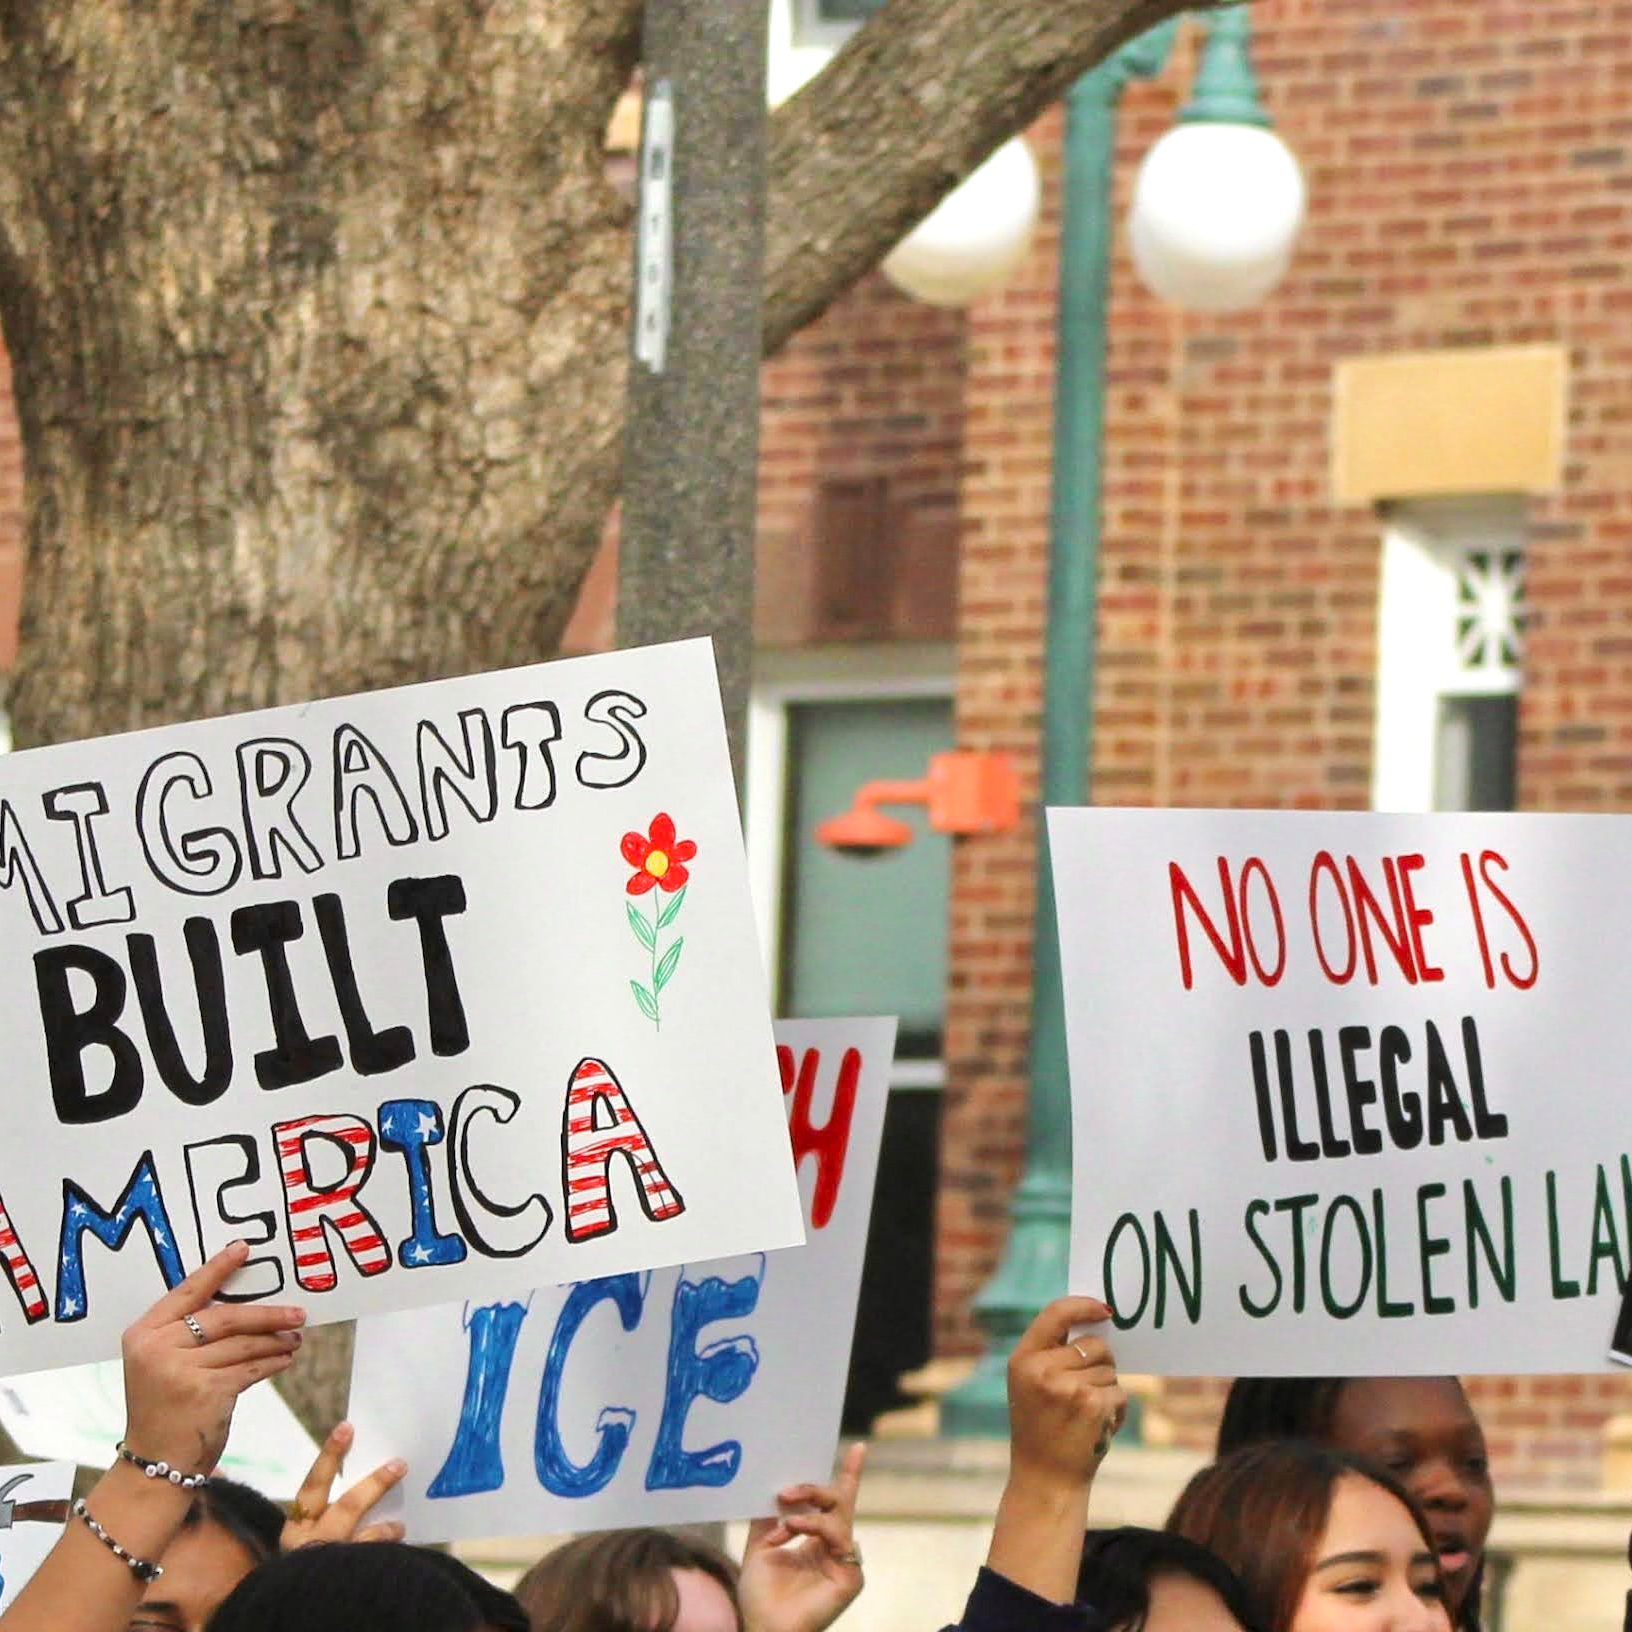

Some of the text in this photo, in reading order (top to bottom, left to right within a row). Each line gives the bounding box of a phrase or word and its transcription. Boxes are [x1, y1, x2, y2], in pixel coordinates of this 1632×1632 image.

[1168, 849, 1539, 991] NO ONE IS
[32, 874, 471, 1126] BUILT
[1249, 1016, 1508, 1162] ILLEGAL
[1103, 1208, 1202, 1330] ON
[1239, 1175, 1516, 1320] STOLEN
[426, 1252, 766, 1499] ICE
